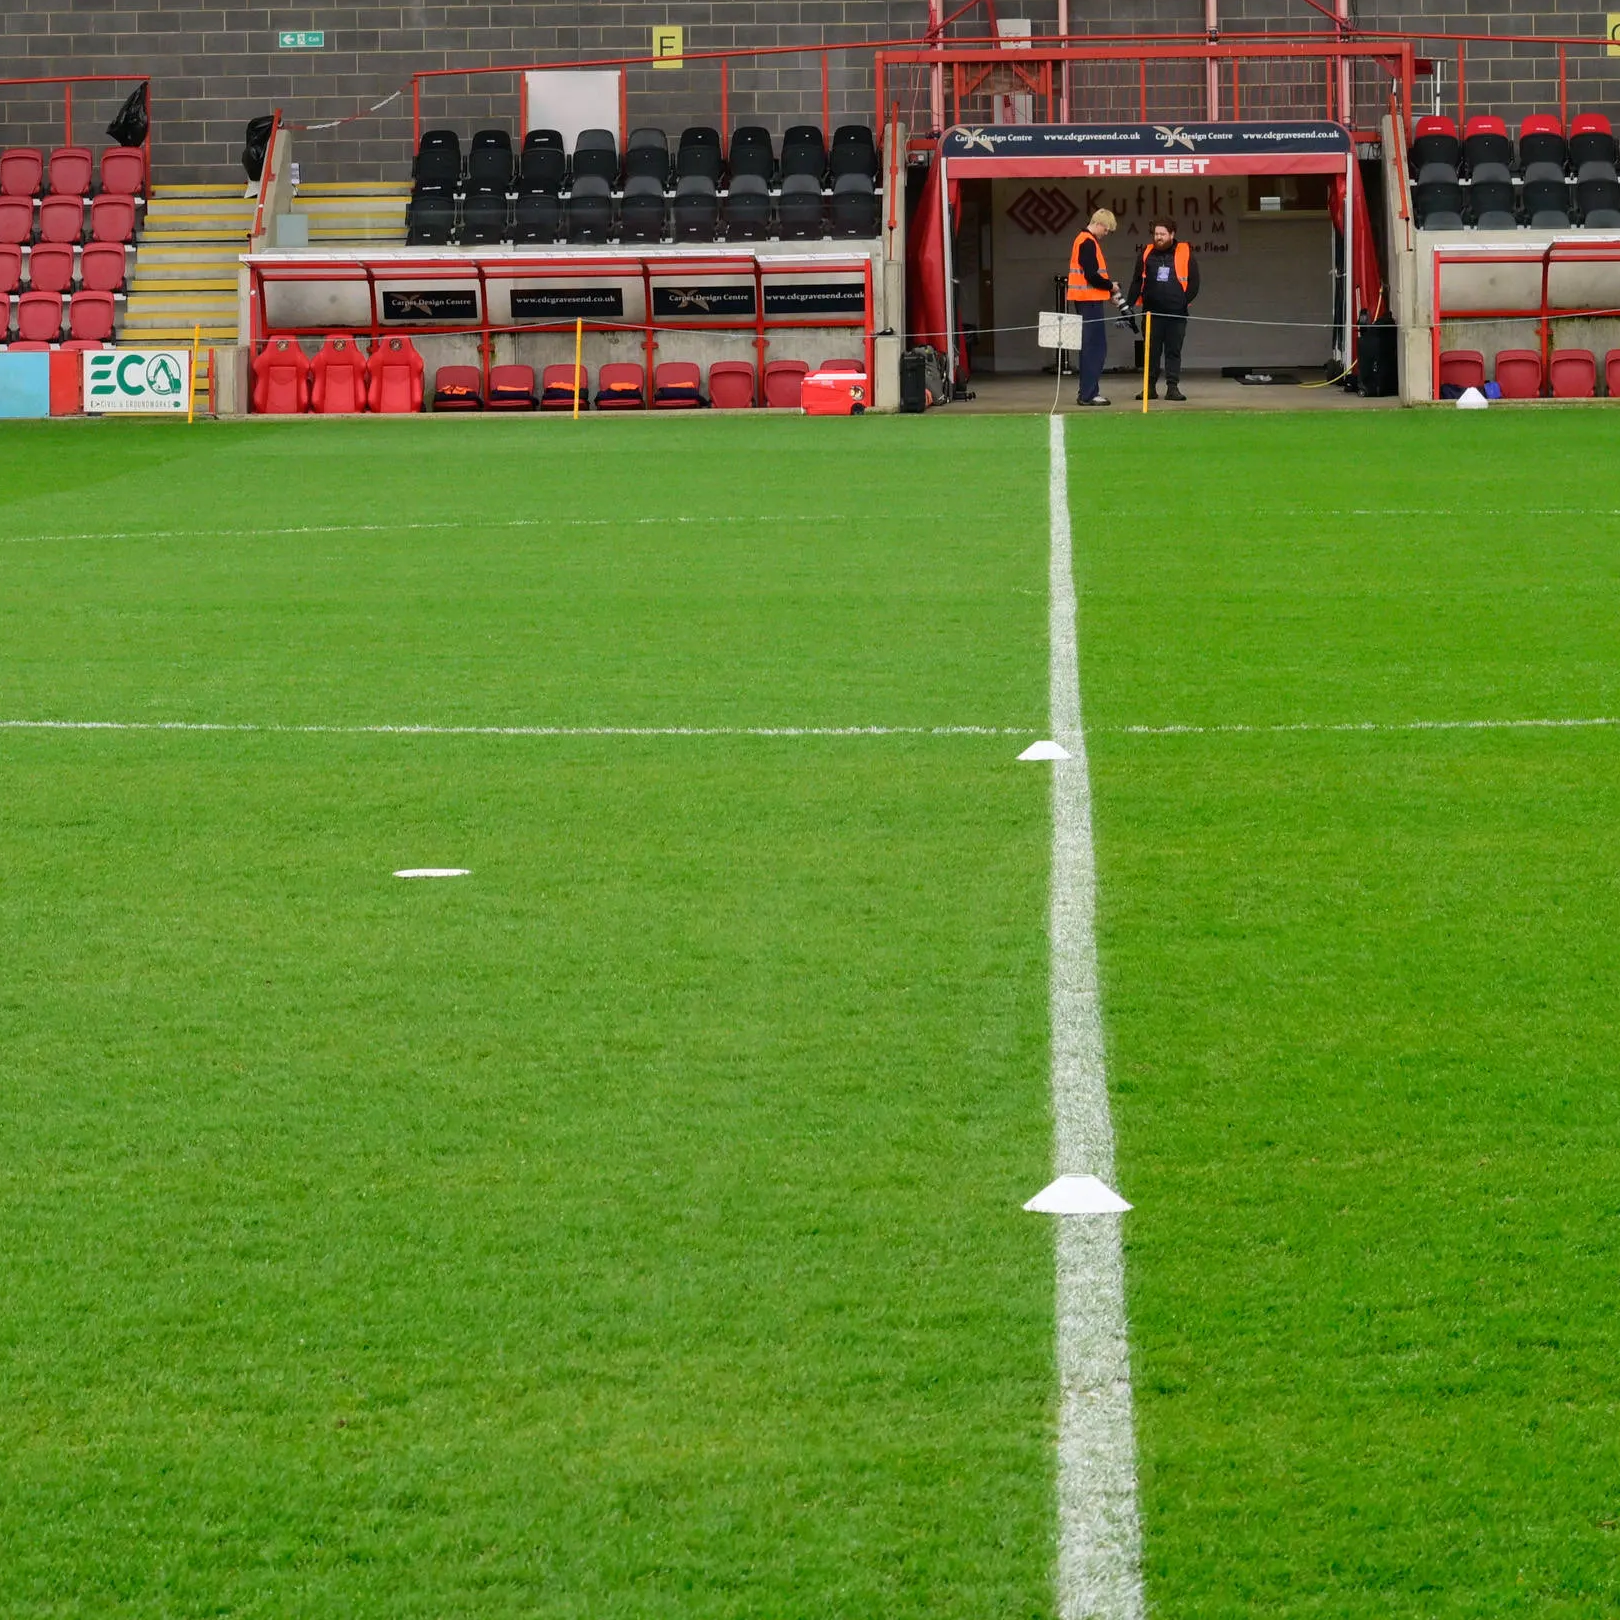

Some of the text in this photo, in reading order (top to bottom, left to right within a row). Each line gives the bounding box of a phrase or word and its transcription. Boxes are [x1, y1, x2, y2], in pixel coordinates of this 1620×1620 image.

[660, 36, 675, 58] F
[955, 133, 1033, 143] Carpet Design Centre
[1044, 132, 1141, 142] www.cdcgravesend.co.uk
[1155, 132, 1233, 142] Carpet Design Centre
[1242, 130, 1340, 140] www.cdcgravesend.co.uk
[1083, 158, 1209, 175] THE FLEET
[1085, 184, 1225, 216] Kuflink
[418, 297, 444, 307] Design
[446, 297, 472, 306] Centre
[516, 295, 616, 305] www.cdcgravesend.co.uk
[695, 293, 722, 302] Design
[723, 293, 749, 301] Centre
